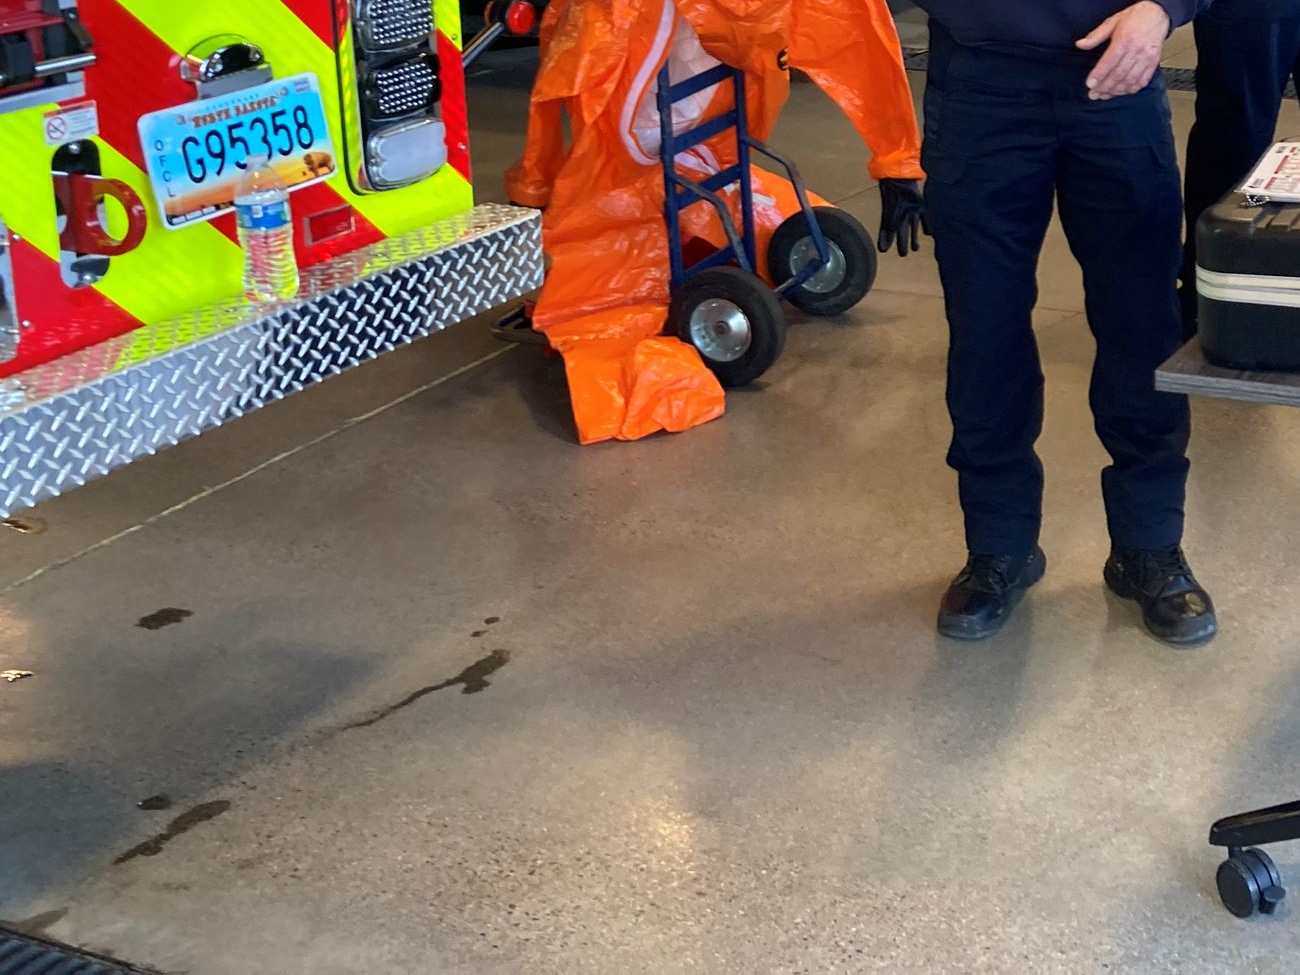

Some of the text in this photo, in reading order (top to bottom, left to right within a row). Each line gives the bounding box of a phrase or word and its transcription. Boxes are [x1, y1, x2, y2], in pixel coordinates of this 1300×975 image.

[192, 108, 231, 129] NORTH
[234, 96, 278, 117] DAKOTA
[154, 139, 176, 199] OFCL
[182, 105, 314, 184] G95358
